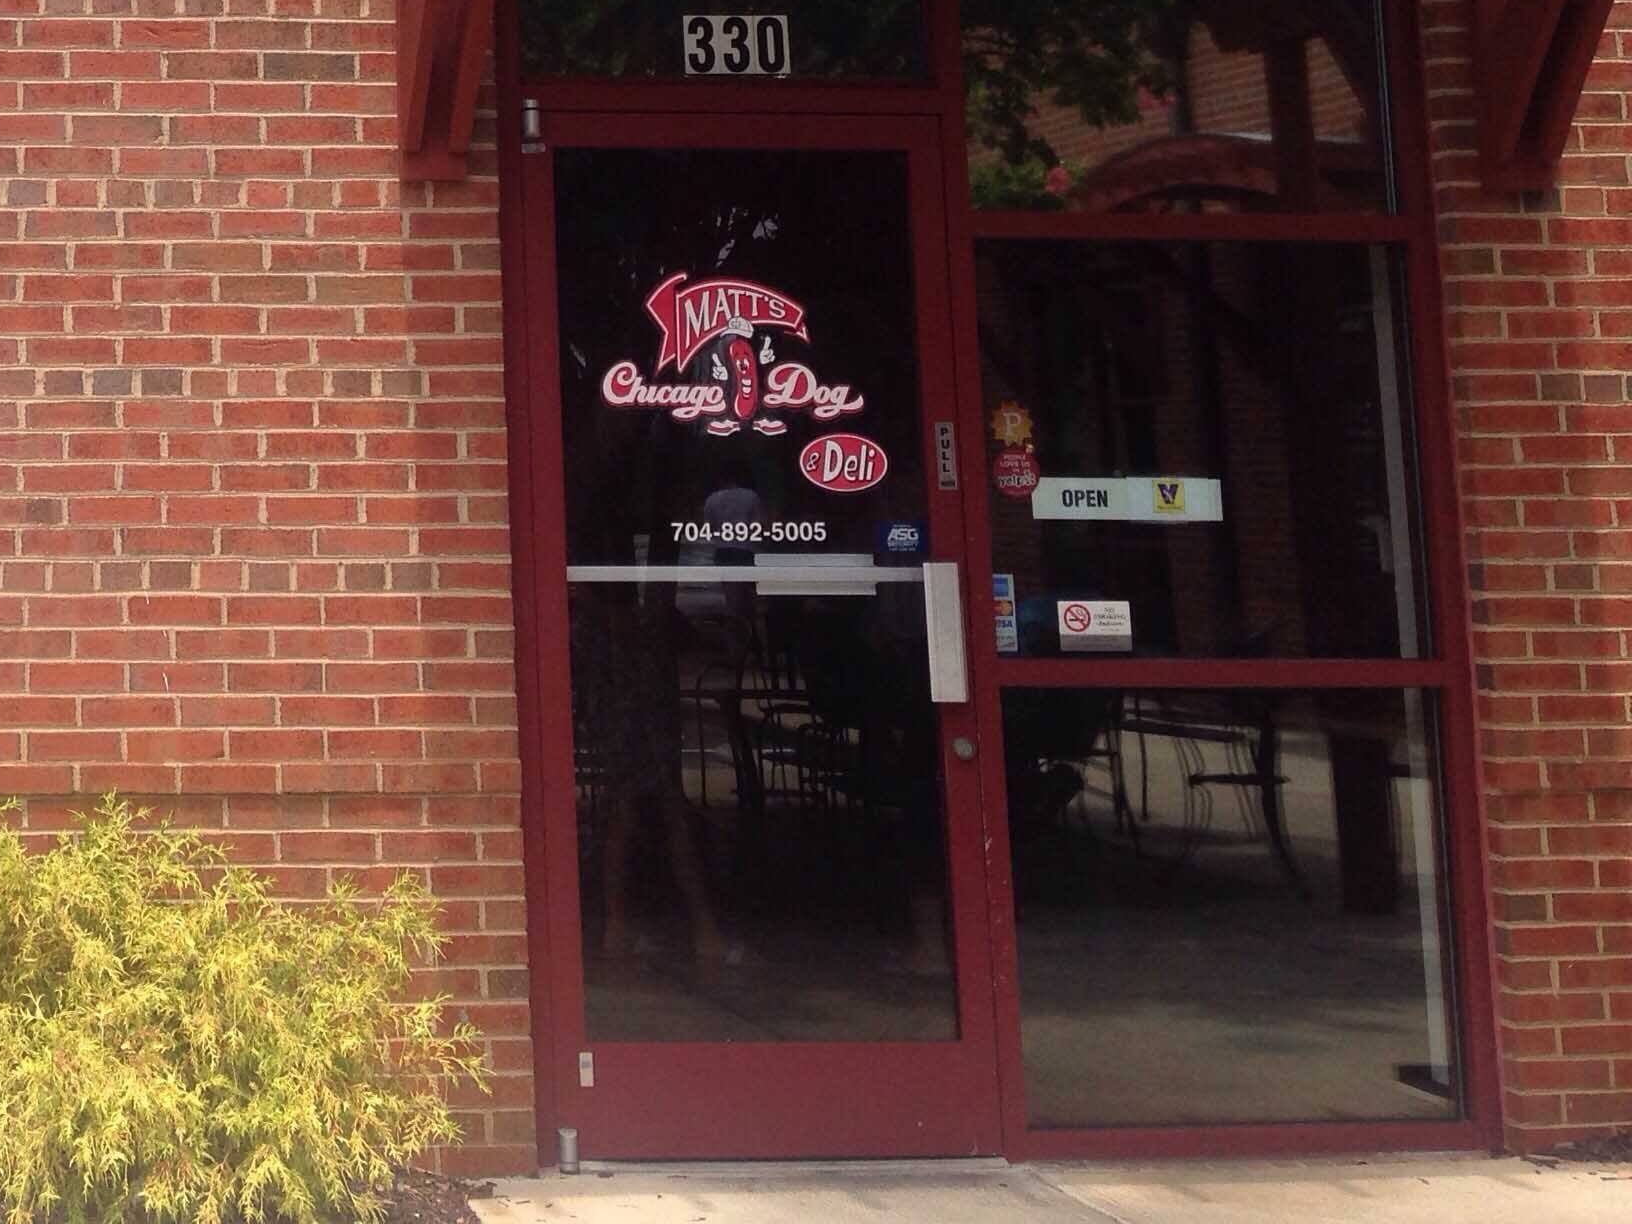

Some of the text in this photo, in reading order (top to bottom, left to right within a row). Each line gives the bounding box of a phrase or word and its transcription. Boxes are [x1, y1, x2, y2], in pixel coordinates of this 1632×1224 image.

[687, 16, 785, 74] 330
[684, 287, 786, 349] MATT'S
[603, 361, 865, 419] Chicago Dog
[806, 439, 876, 483] & Deli
[940, 427, 952, 473] PULL
[1061, 489, 1109, 508] OPEN
[670, 522, 827, 543] 704-892-5005
[887, 528, 919, 541] ASG
